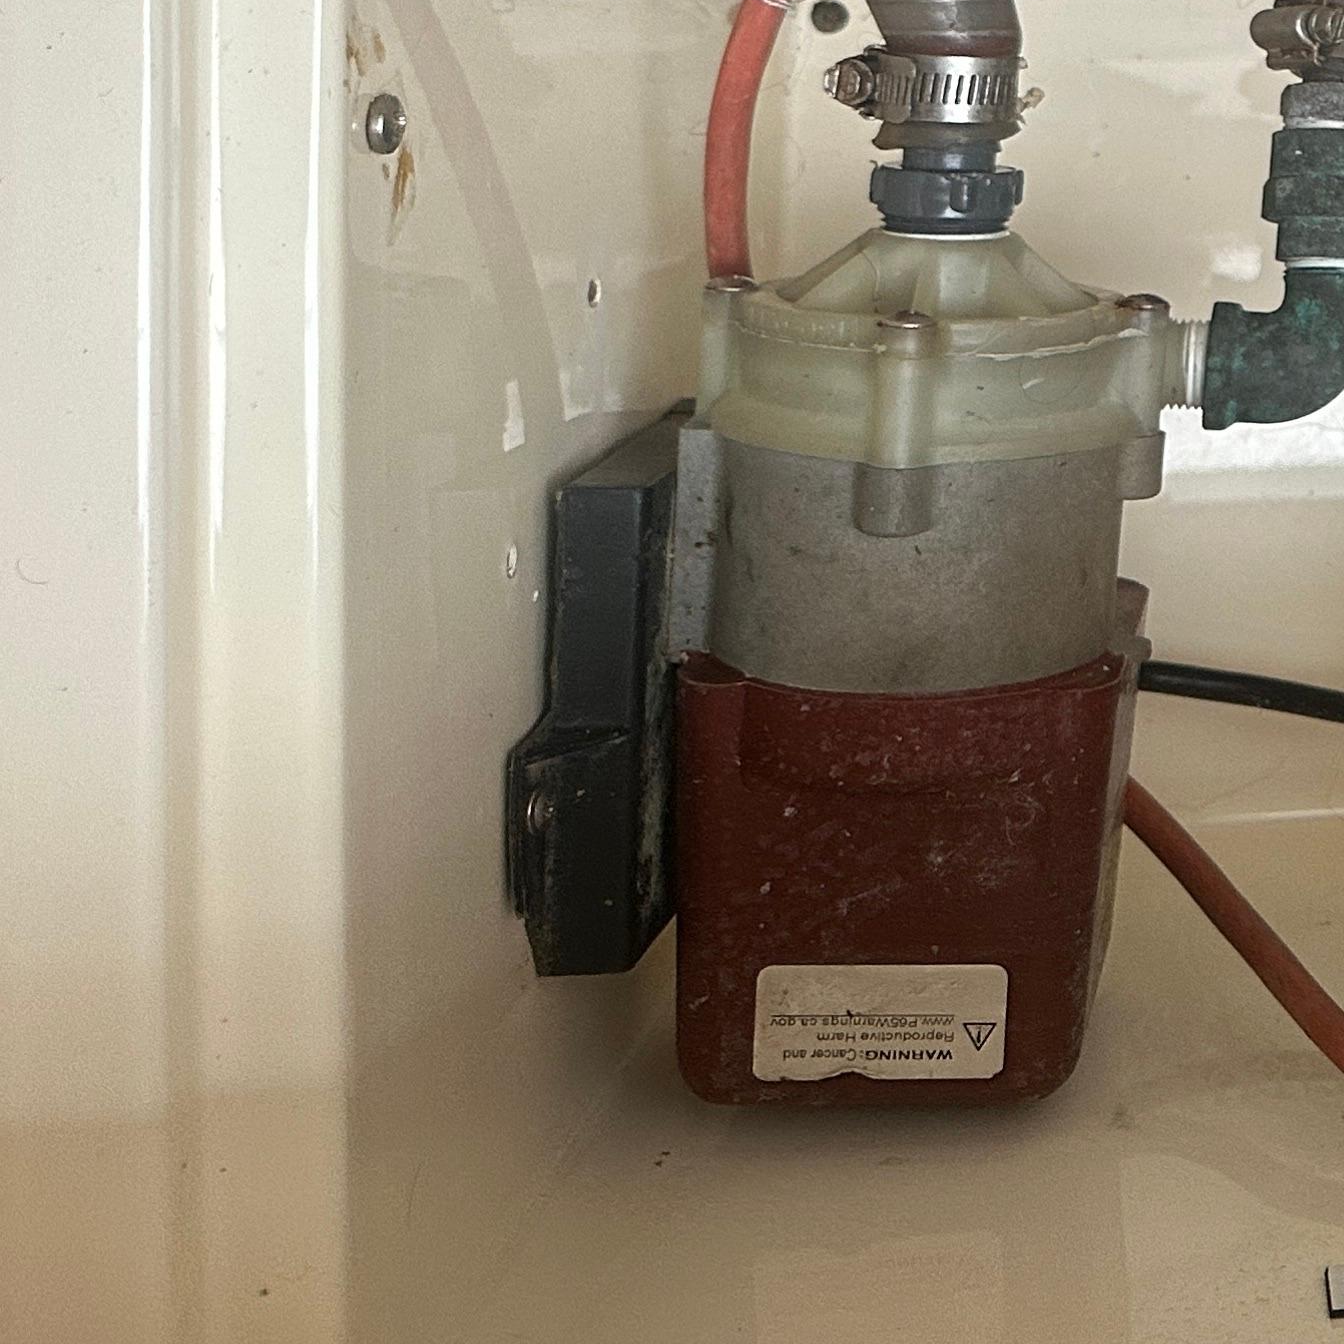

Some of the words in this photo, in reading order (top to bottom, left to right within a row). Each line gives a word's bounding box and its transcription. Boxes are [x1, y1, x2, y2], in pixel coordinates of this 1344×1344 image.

[816, 1032, 857, 1042] Harm
[861, 1030, 955, 1043] Reproductive
[783, 1049, 807, 1061] and
[811, 1048, 857, 1061] Cancer
[860, 1049, 953, 1061] WARNING:
